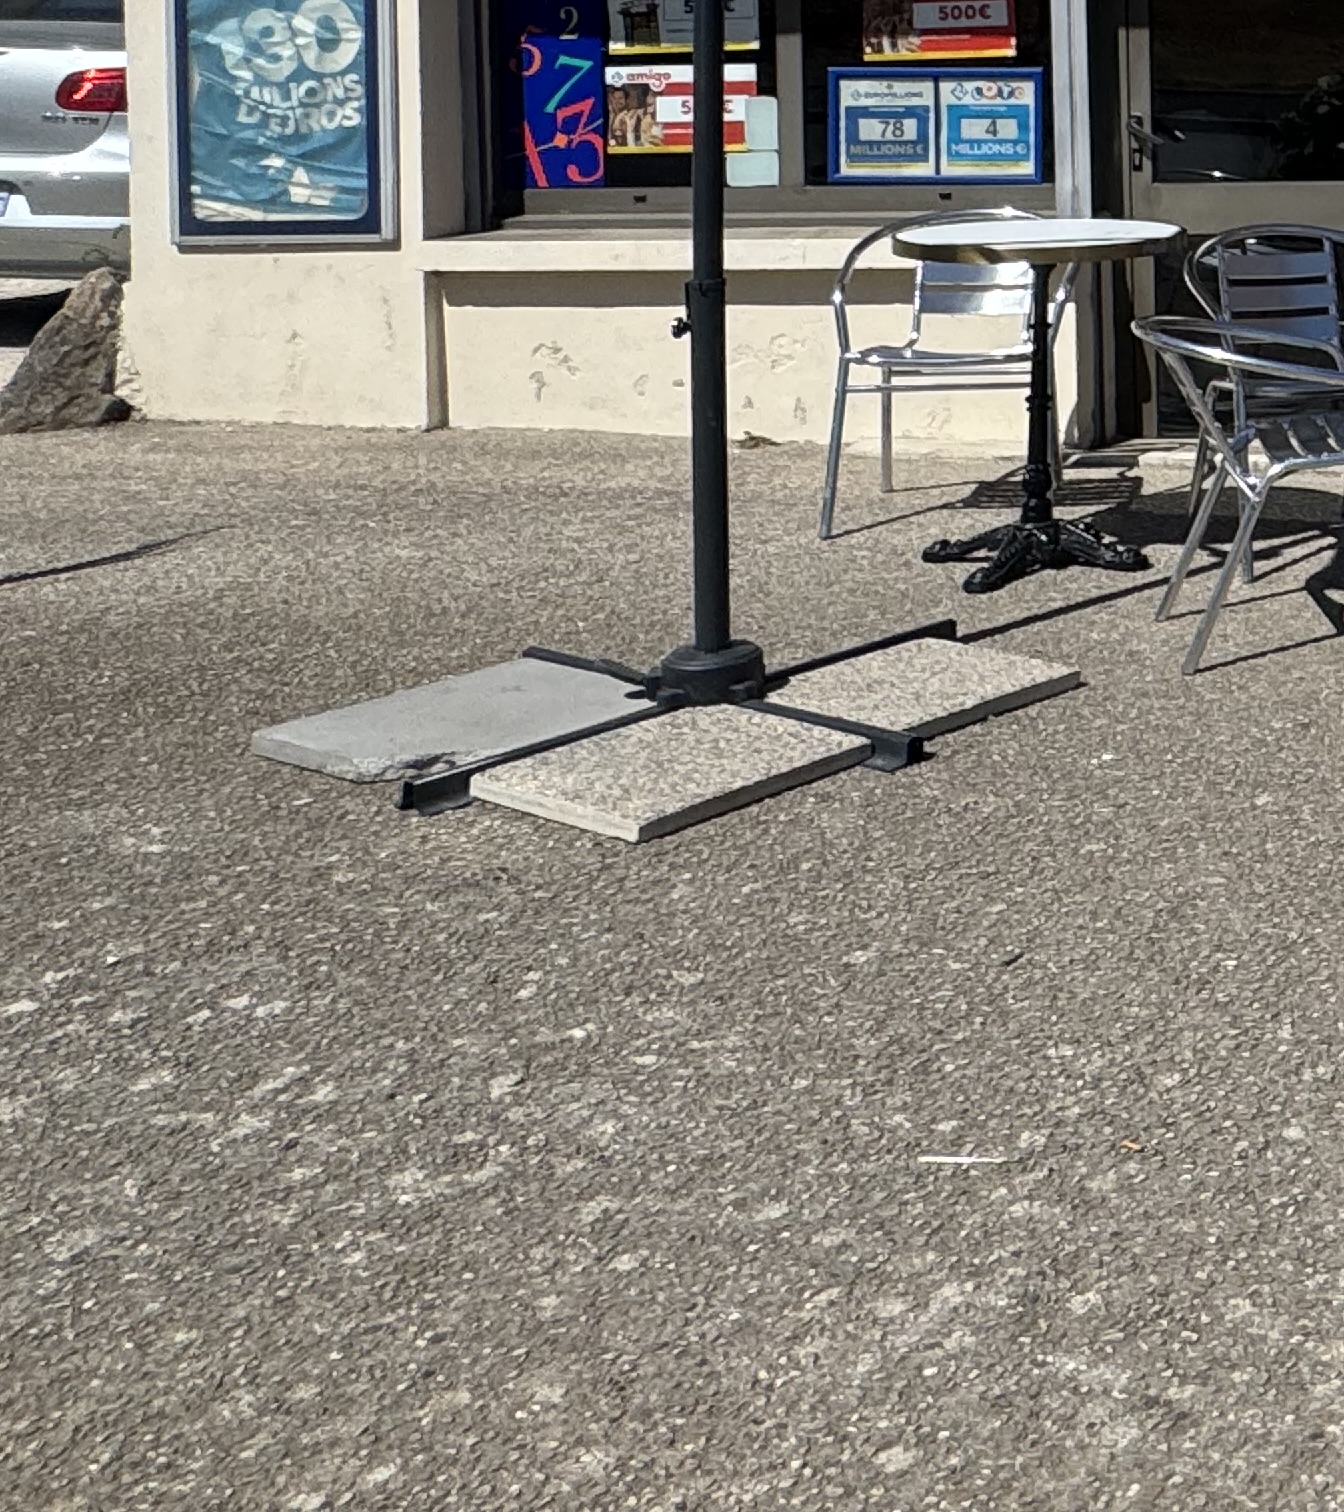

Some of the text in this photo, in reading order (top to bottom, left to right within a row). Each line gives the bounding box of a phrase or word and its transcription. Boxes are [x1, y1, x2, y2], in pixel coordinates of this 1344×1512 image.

[937, 3, 992, 22] 500€
[626, 67, 672, 90] amigo
[878, 120, 905, 139] 78
[984, 119, 1000, 139] 4
[850, 142, 915, 156] MILLIONS
[951, 143, 1014, 156] MILLIONS
